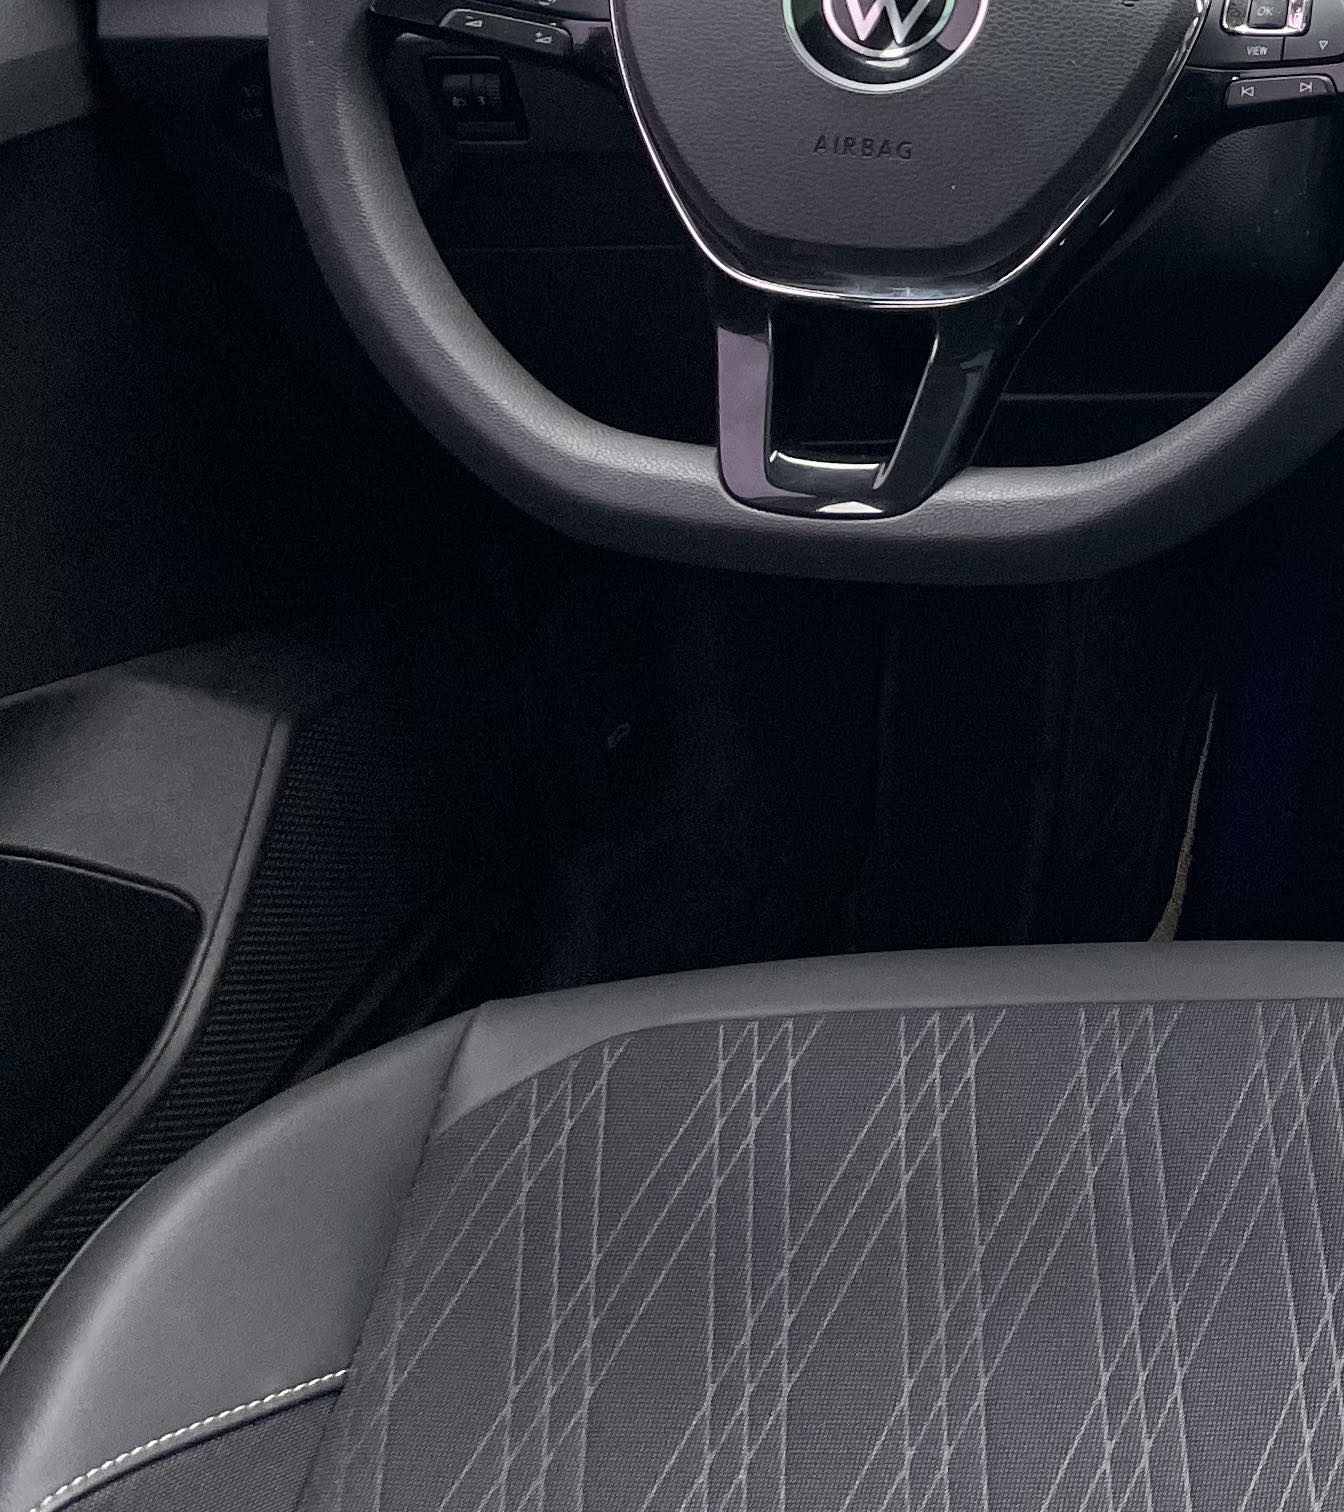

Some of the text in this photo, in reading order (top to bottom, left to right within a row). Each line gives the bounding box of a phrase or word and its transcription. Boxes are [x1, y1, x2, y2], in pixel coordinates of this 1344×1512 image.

[1256, 6, 1273, 18] OK
[1246, 45, 1269, 57] VIEW
[813, 134, 914, 160] AIRBAG
